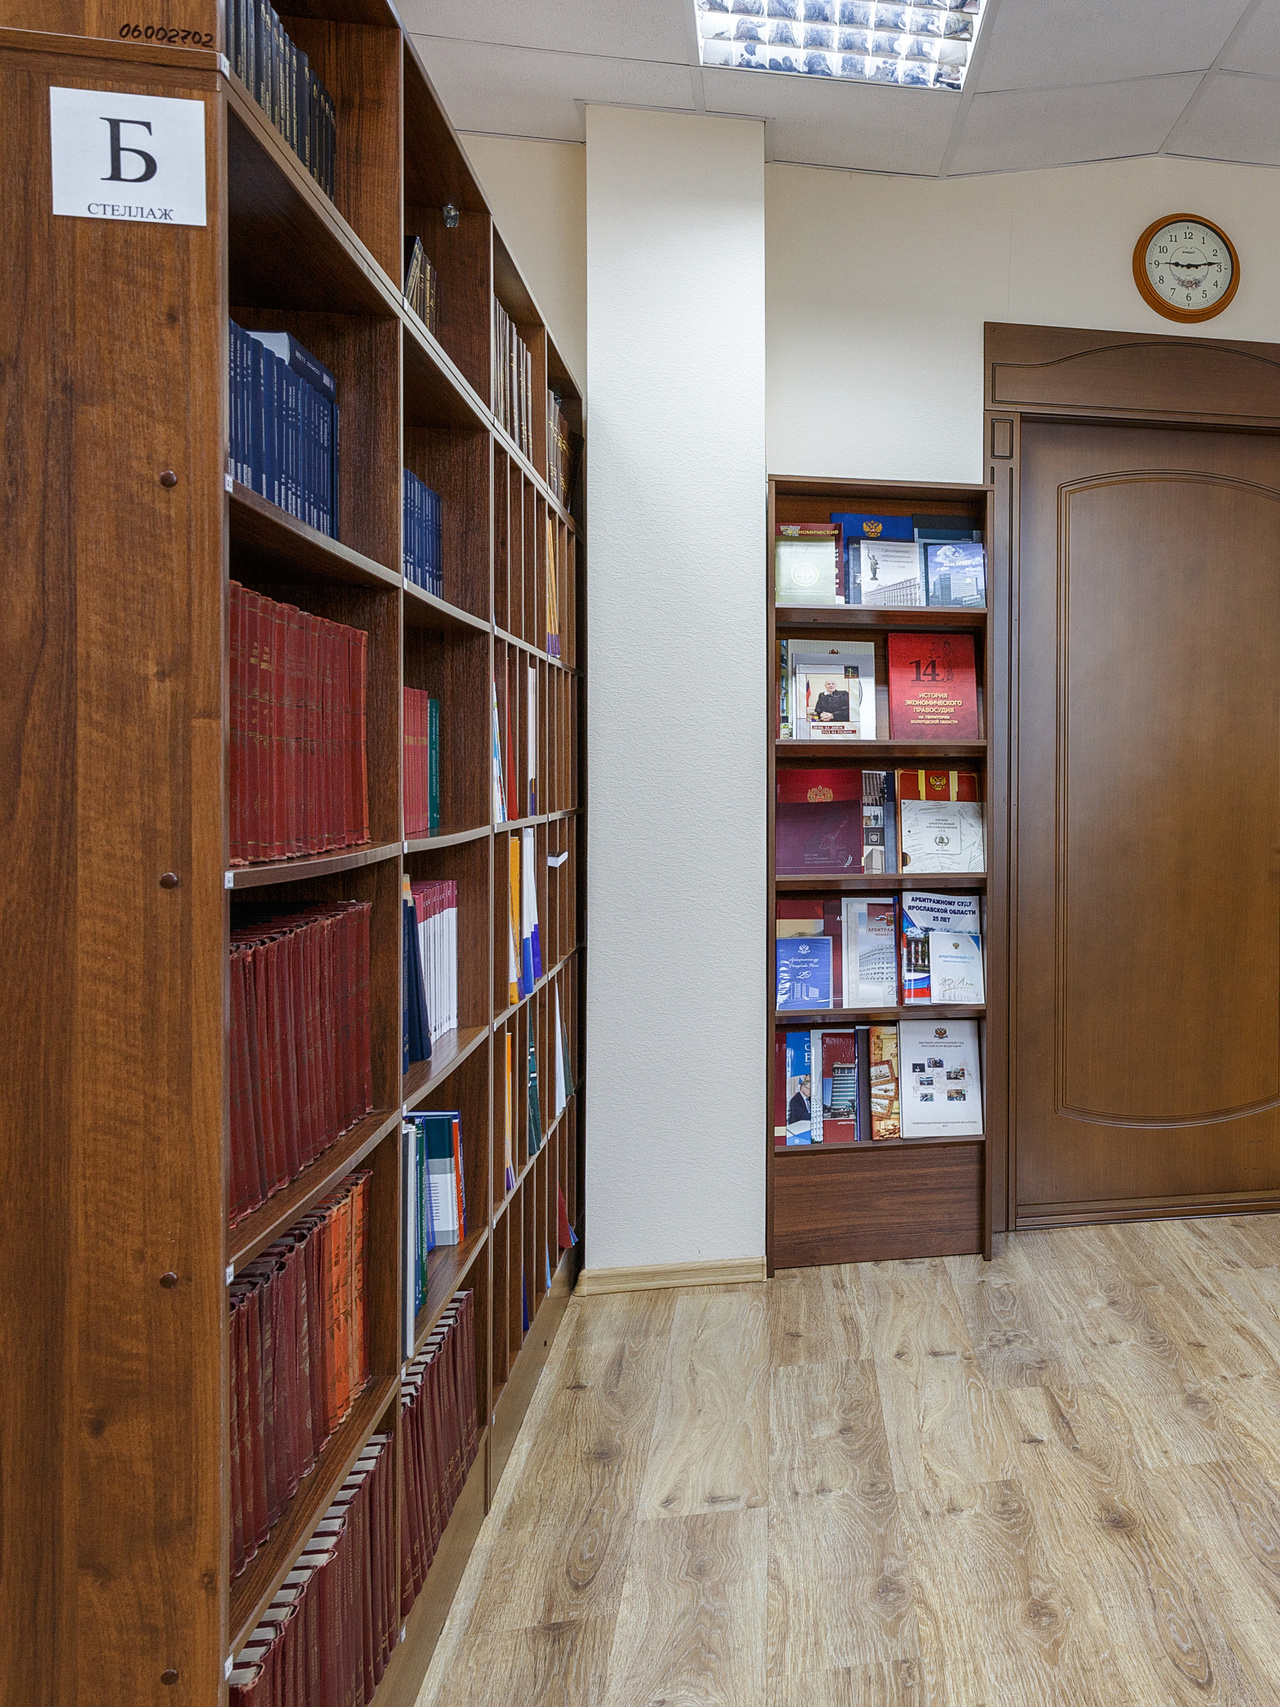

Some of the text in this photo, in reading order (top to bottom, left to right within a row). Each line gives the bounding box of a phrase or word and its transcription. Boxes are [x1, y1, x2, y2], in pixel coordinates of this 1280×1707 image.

[119, 23, 213, 48] 06002702
[100, 117, 157, 183] Б
[87, 202, 173, 221] СТЕЛЛАЖ
[1169, 234, 1178, 243] 11
[1183, 231, 1194, 240] 12
[1202, 236, 1206, 245] 1
[1159, 245, 1168, 254] 10
[1212, 249, 1218, 257] 2
[1154, 260, 1160, 269] 9
[1216, 264, 1223, 273] 3
[1158, 275, 1165, 285] 8
[1212, 280, 1218, 289] 4
[1170, 288, 1177, 297] 7
[1186, 292, 1192, 301] 6
[1202, 290, 1208, 299] 5
[909, 659, 940, 682] 14
[911, 897, 956, 906] АРБИТРАЖНОМУ
[908, 905, 948, 914] ЯРОСЛАВСКОЙ
